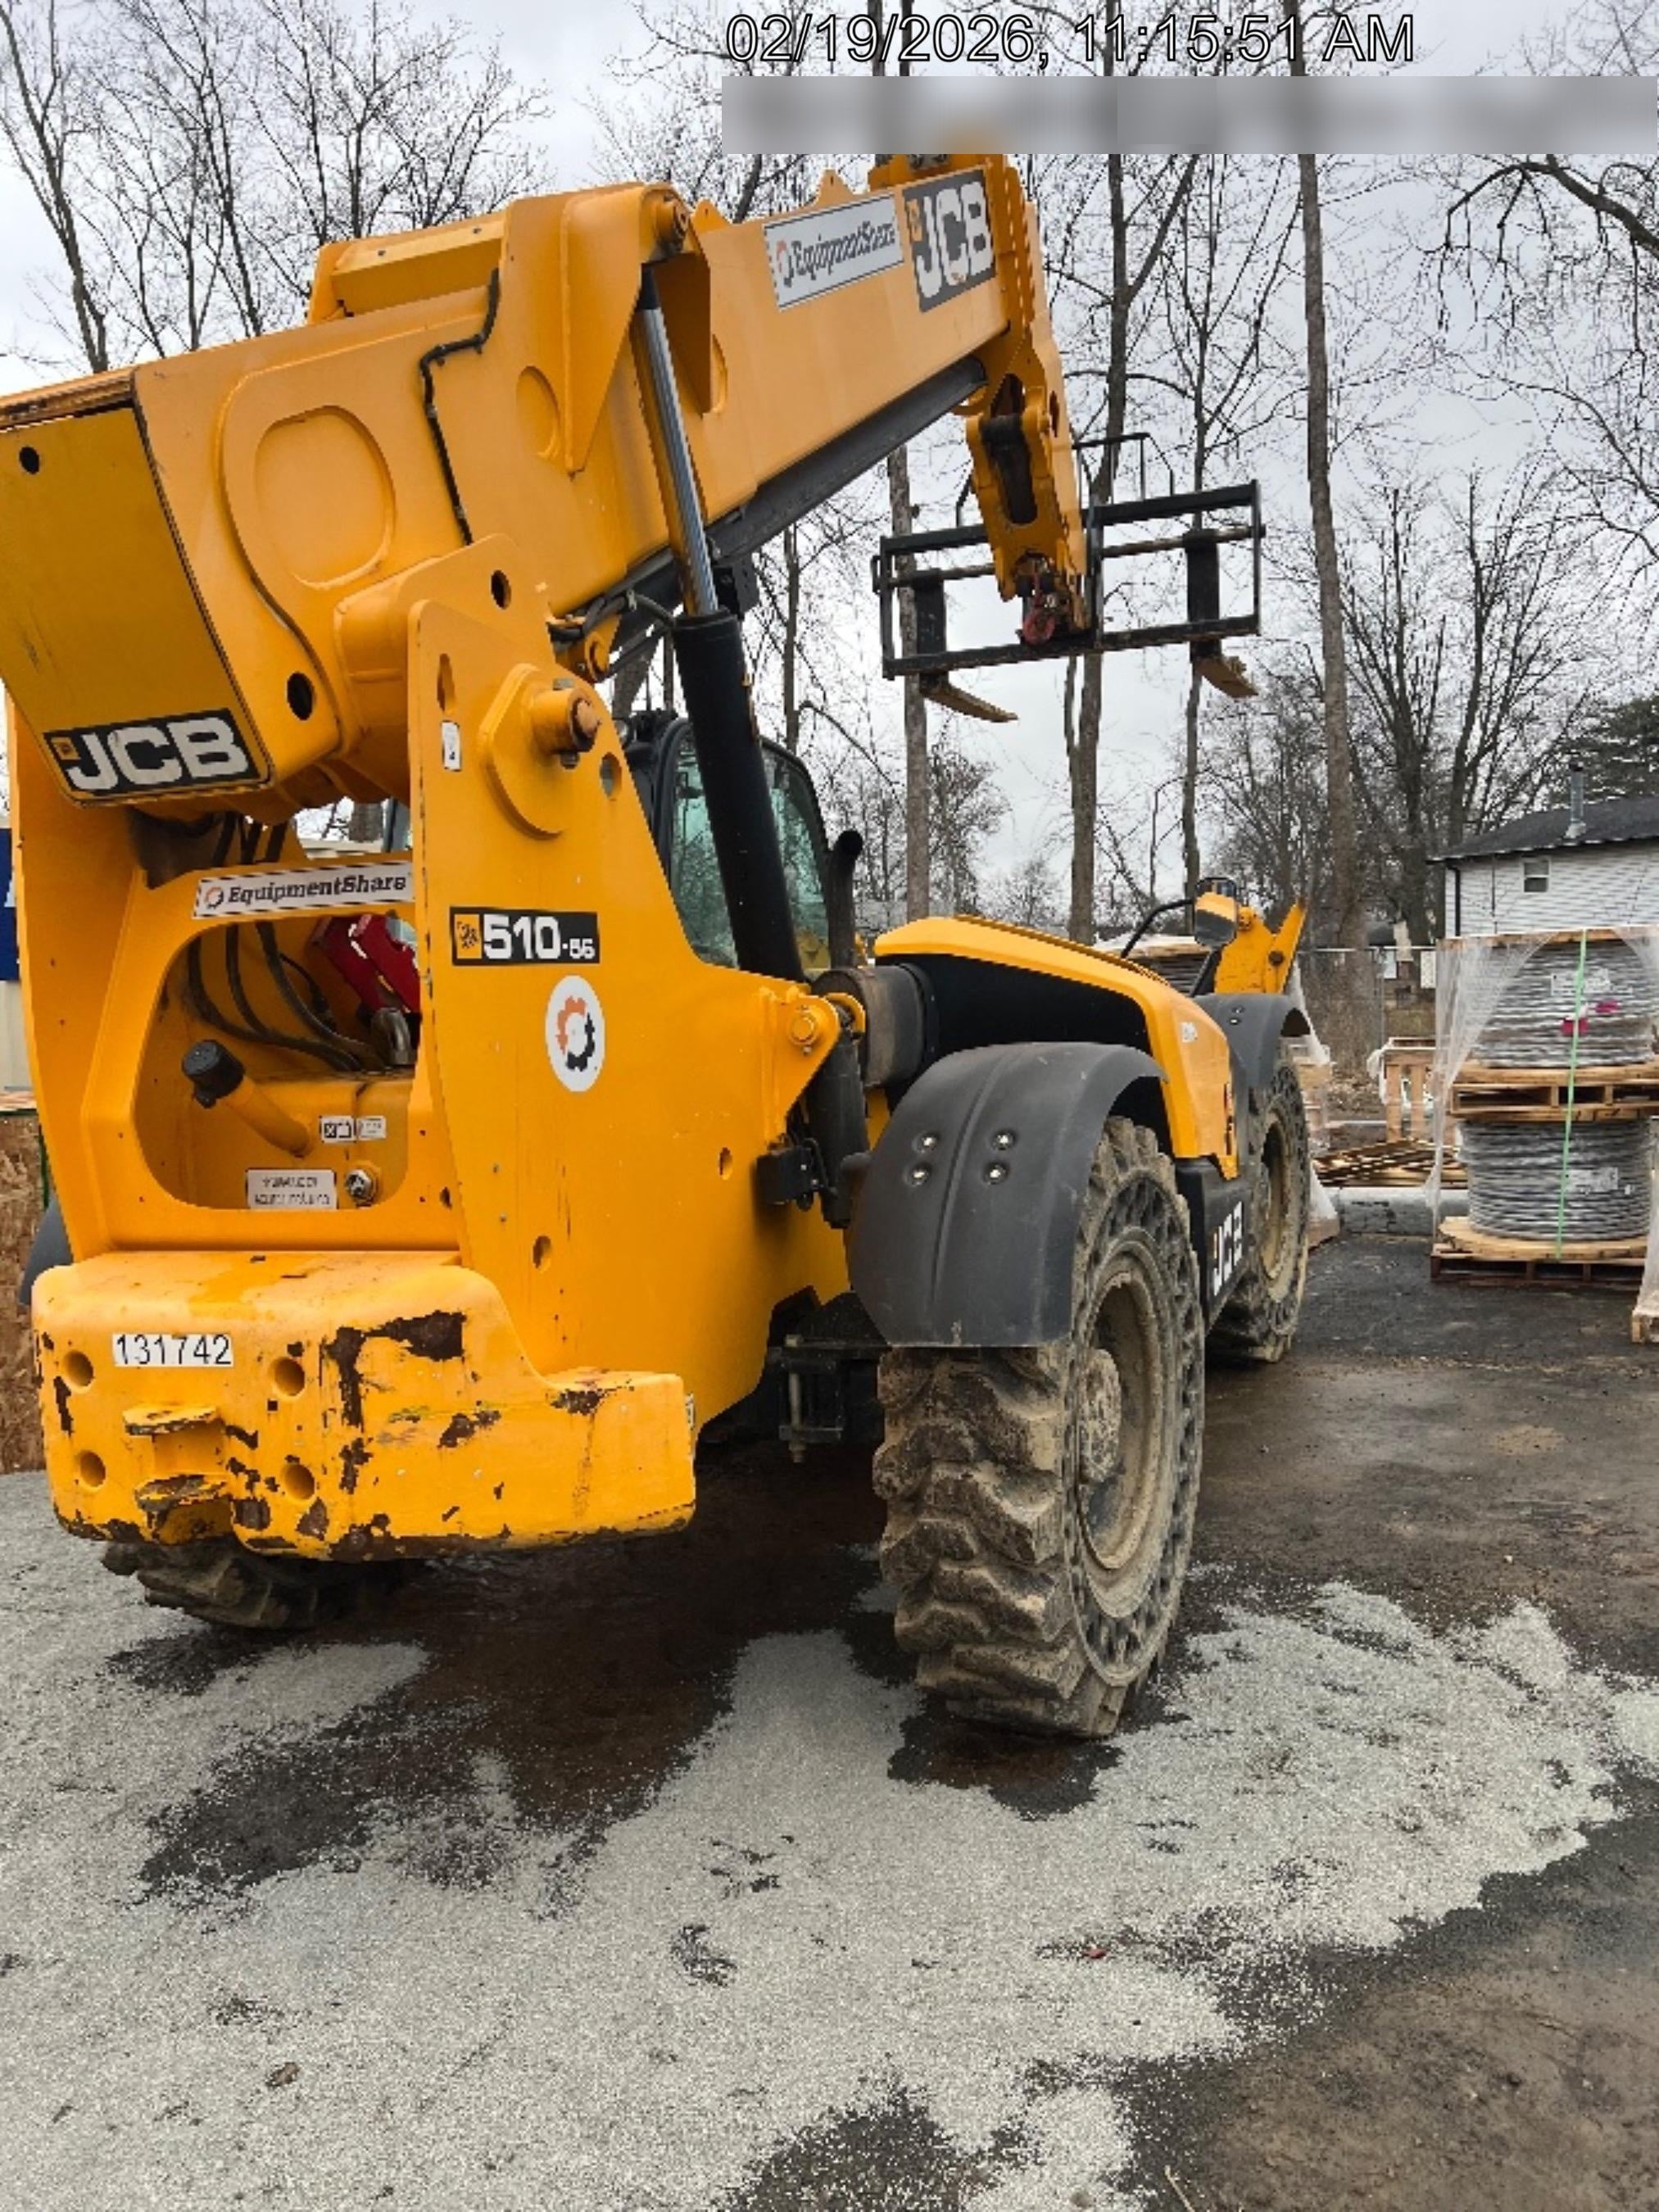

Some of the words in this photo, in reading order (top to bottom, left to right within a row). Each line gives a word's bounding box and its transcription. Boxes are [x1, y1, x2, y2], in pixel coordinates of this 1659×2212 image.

[916, 181, 994, 298] JCB
[66, 716, 248, 791] JCB
[227, 874, 406, 904] EquipmentShare
[1213, 1200, 1243, 1296] JCB
[116, 1333, 232, 1365] 131742
